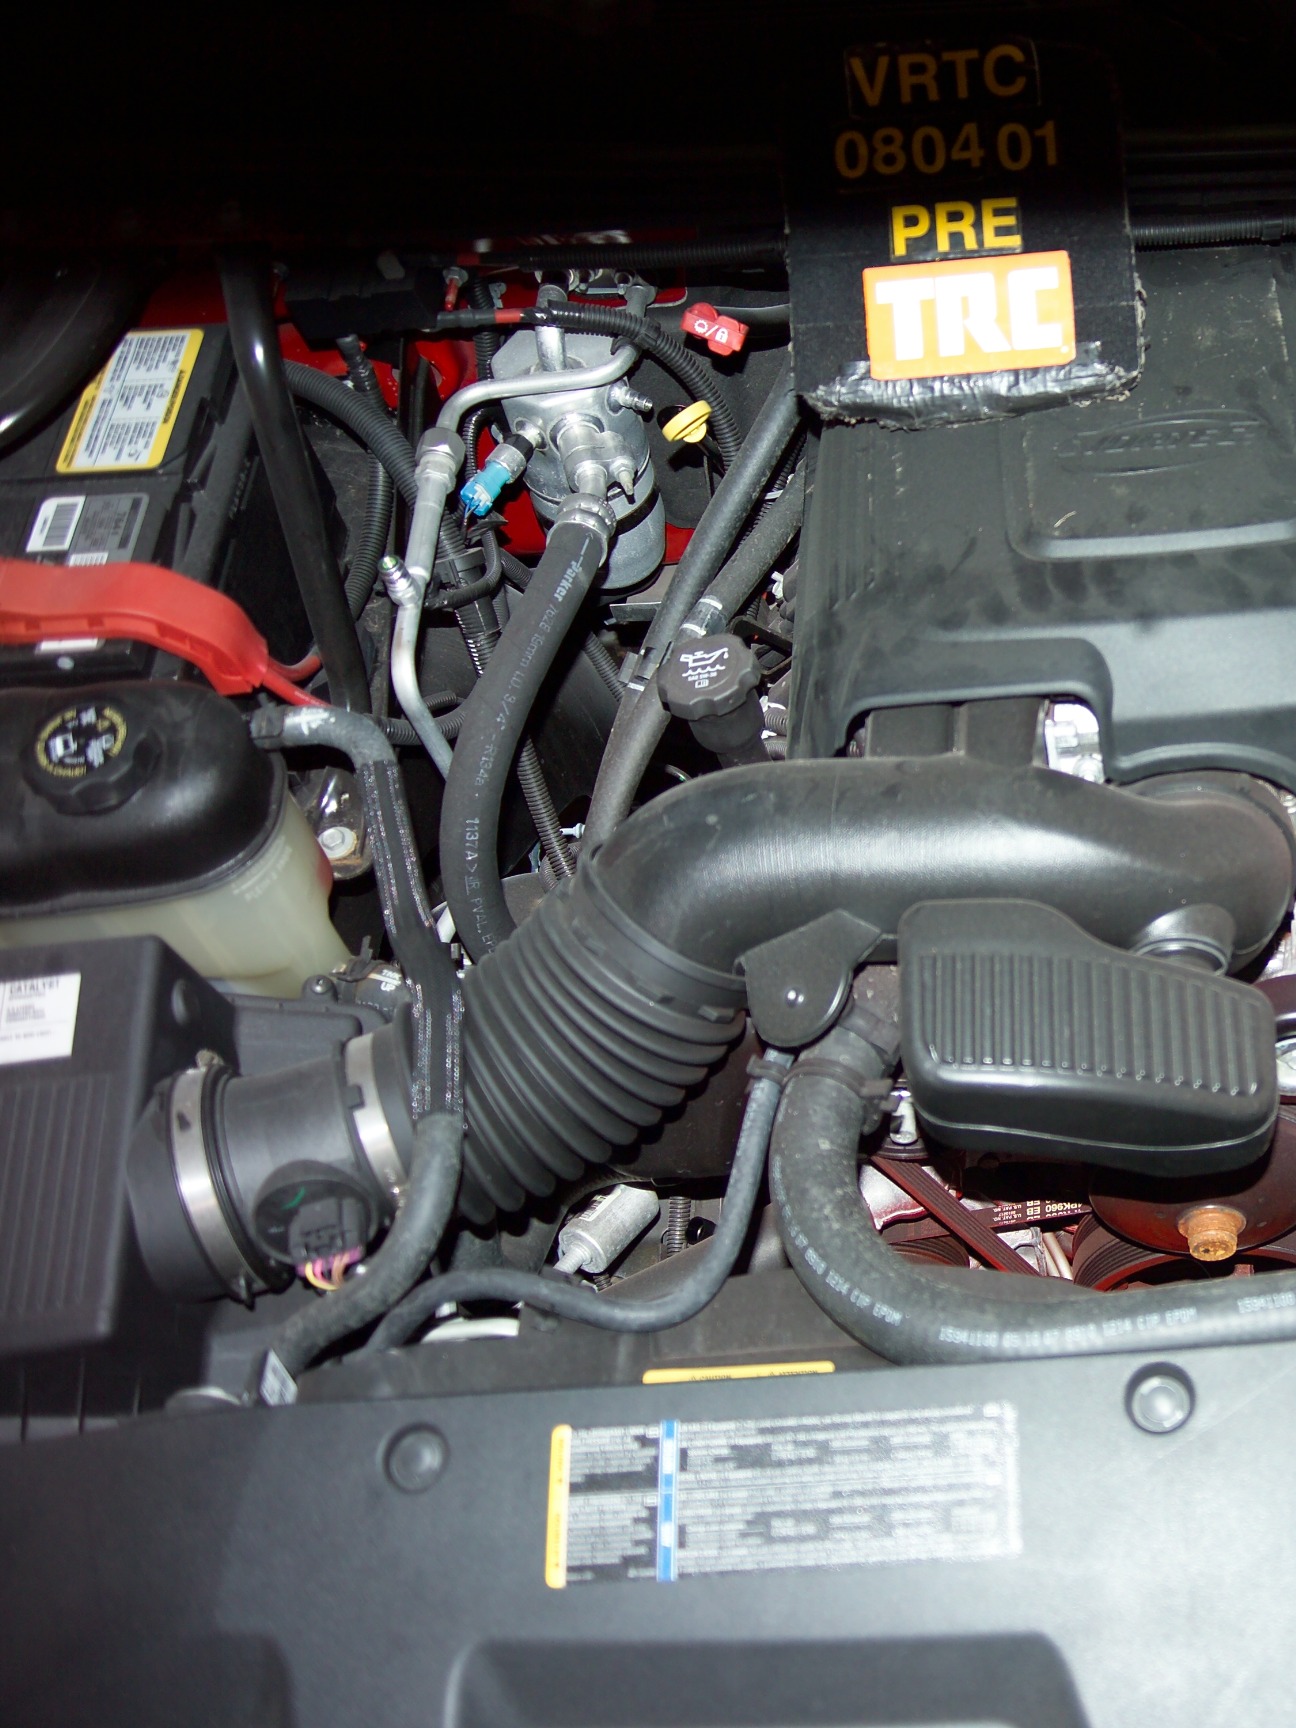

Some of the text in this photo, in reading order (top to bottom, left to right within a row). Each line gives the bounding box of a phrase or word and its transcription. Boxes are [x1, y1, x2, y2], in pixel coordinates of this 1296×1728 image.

[849, 44, 1027, 107] VRTC
[892, 198, 1022, 256] PRE
[875, 266, 1063, 361] TRC
[553, 560, 582, 602] Parker
[1026, 1206, 1041, 1215] EB
